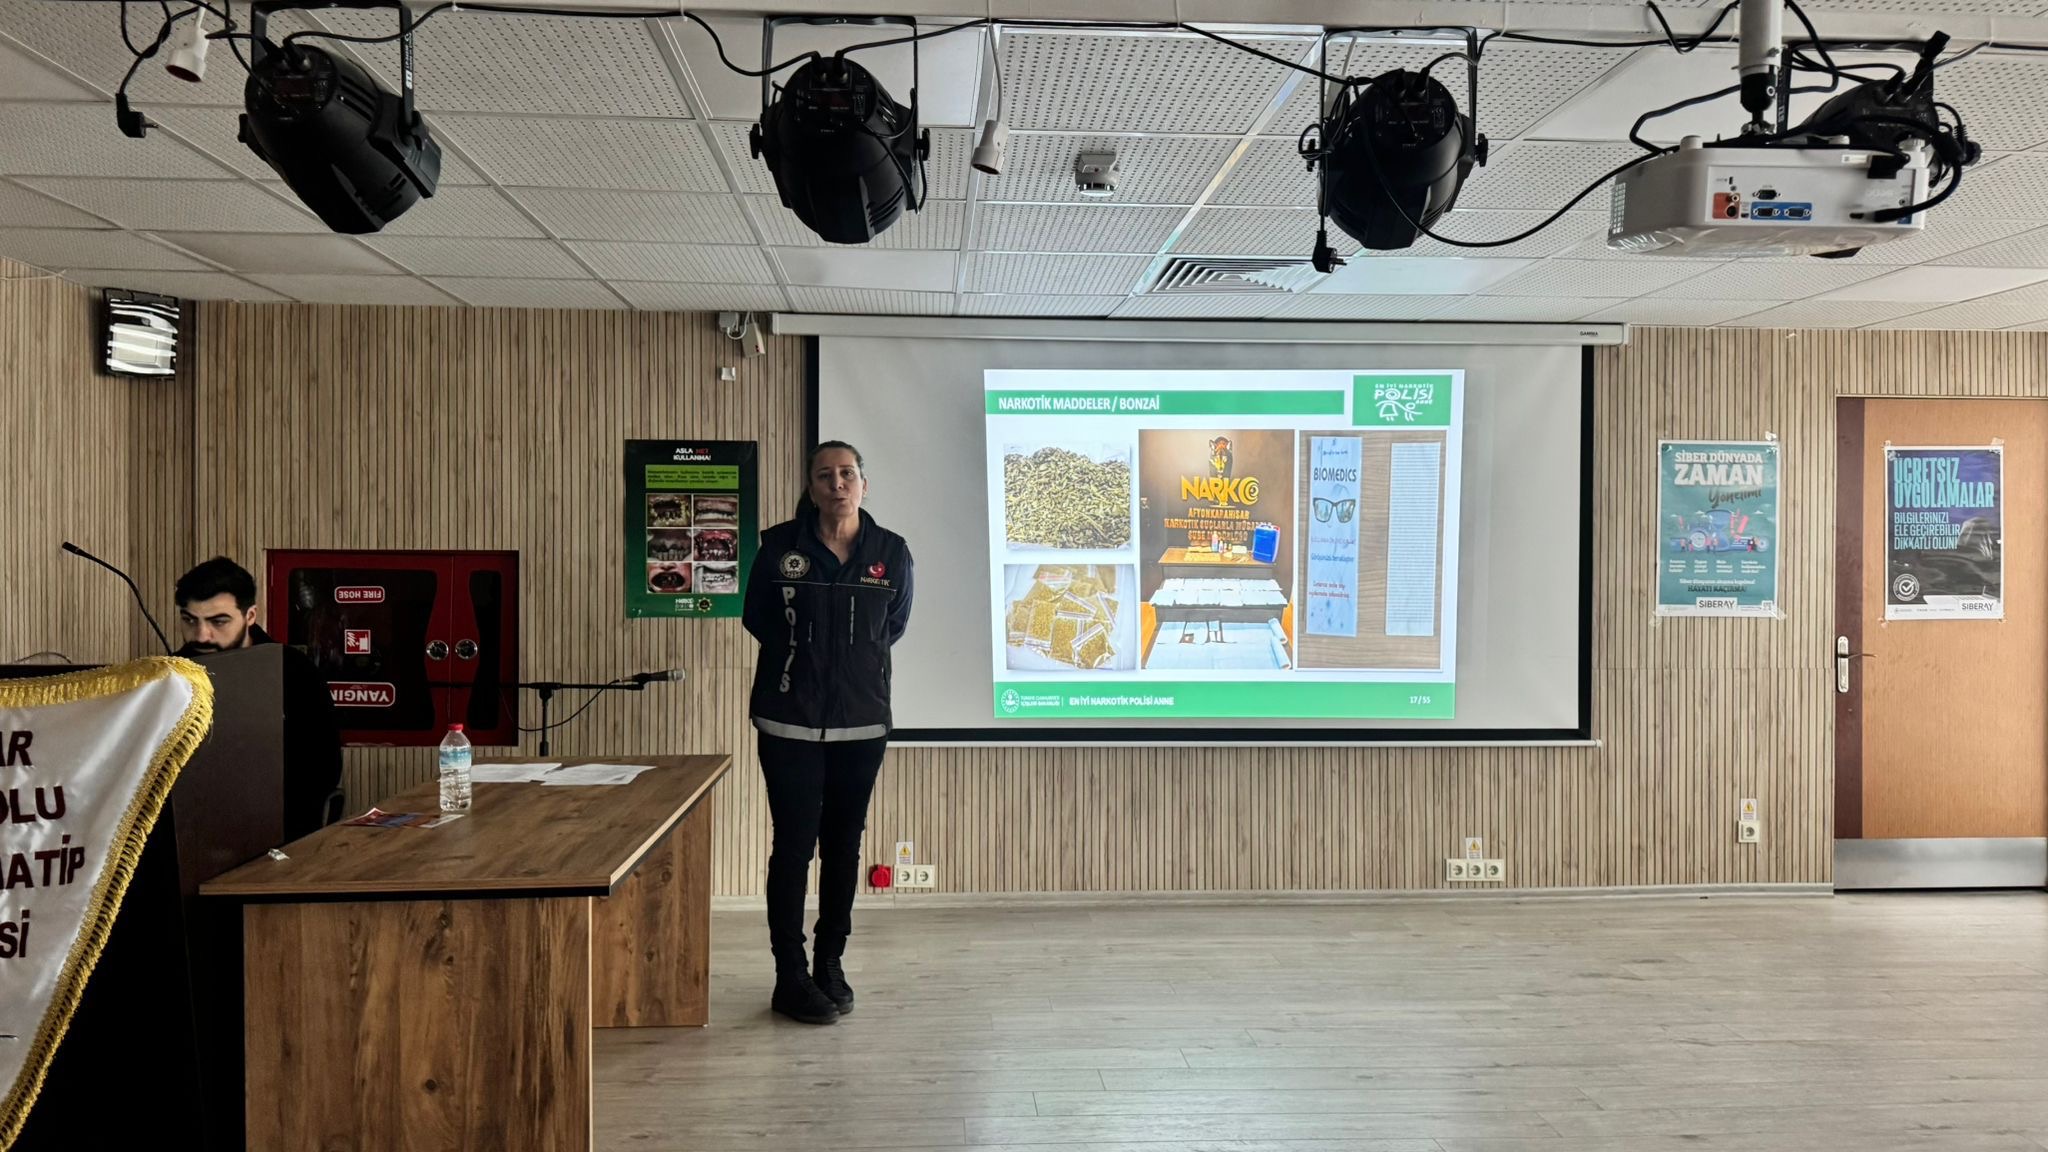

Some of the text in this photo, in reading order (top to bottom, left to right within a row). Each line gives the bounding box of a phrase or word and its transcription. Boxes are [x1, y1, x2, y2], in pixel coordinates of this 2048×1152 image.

[999, 394, 1051, 410] NARKOTİK
[1053, 396, 1110, 410] MADDELER
[1119, 394, 1160, 410] BONZAİ
[1674, 450, 1763, 464] SİBER DÜNYADA
[1313, 467, 1357, 482] BIOMEDICS
[1674, 463, 1764, 486] ZAMAN
[1181, 475, 1260, 505] NARKO
[1894, 481, 1994, 508] UYGULAMALAR
[1894, 524, 1909, 536] ELE
[338, 590, 382, 599] FIRE HOSE
[0, 731, 33, 767] R
[0, 834, 85, 889] ATİP
